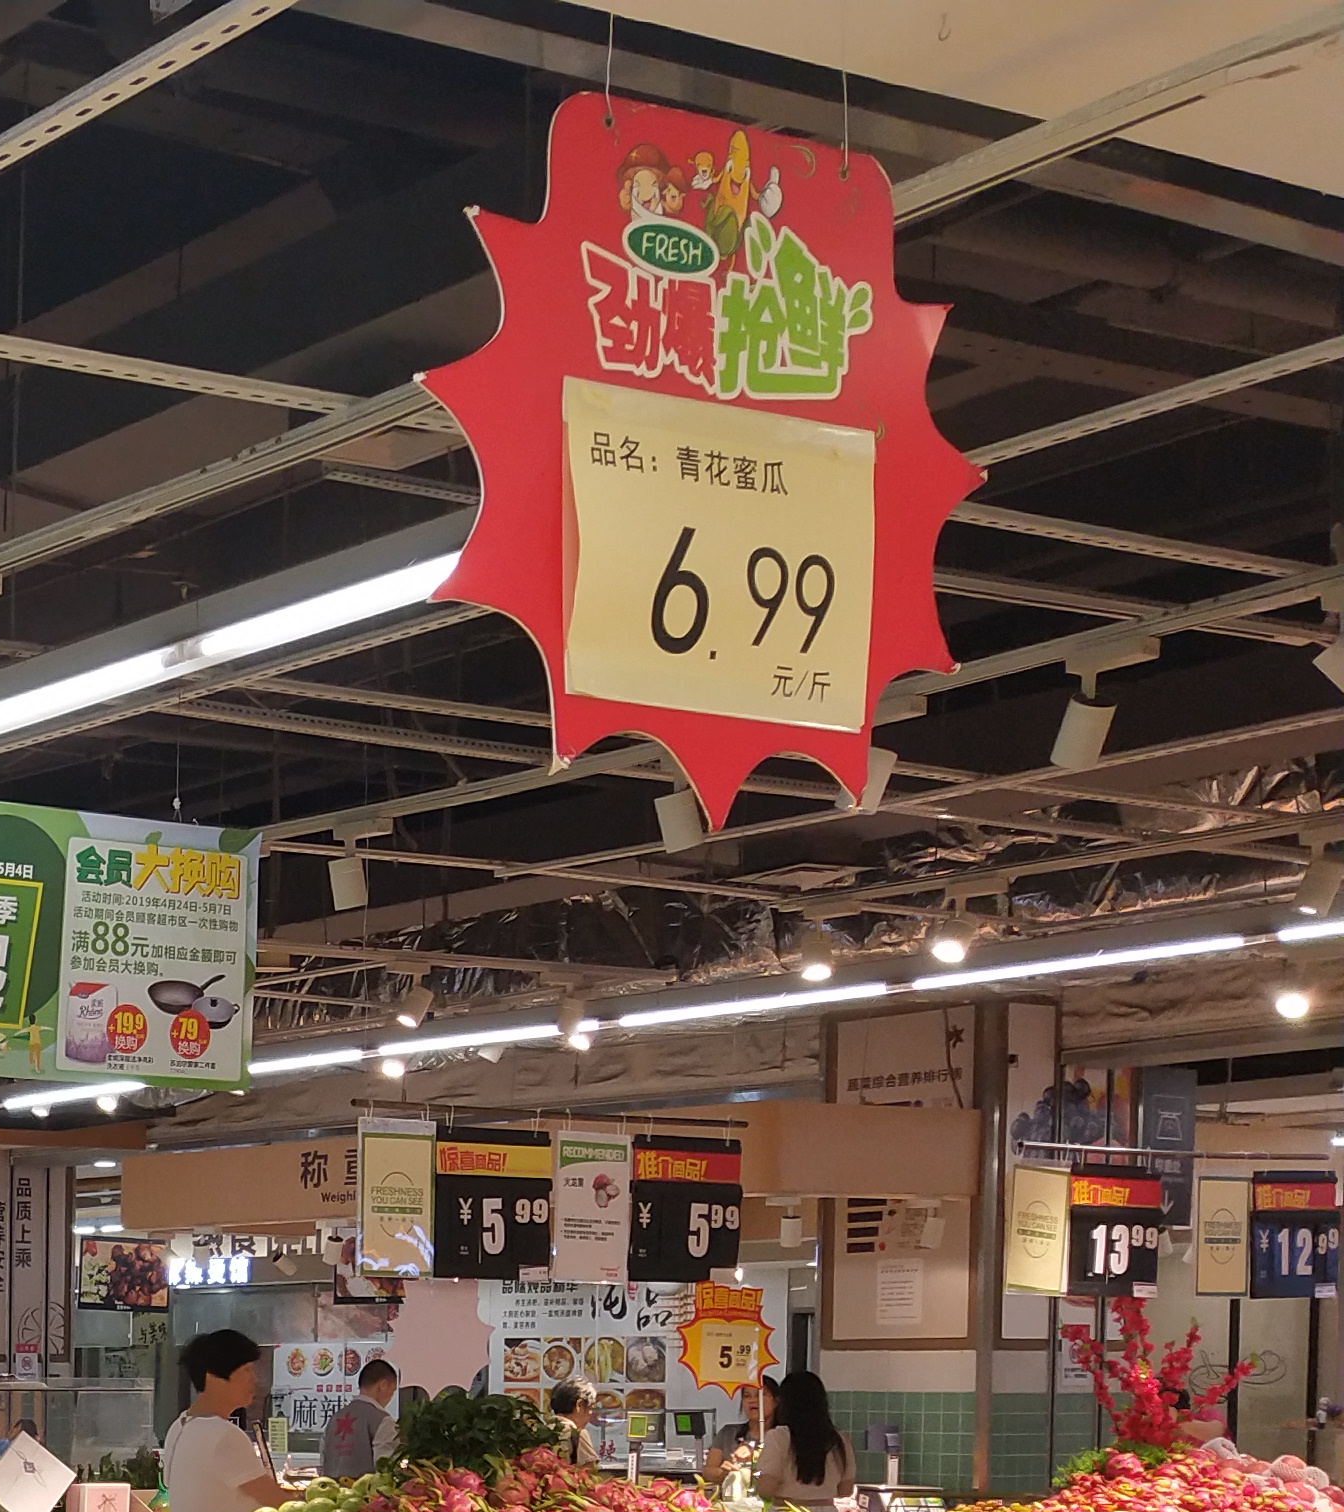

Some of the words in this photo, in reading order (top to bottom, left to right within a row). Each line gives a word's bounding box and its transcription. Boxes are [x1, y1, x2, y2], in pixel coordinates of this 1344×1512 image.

[640, 231, 705, 266] FRESH
[583, 222, 860, 400] 劲爆抢鲜
[651, 526, 837, 661] 6.99
[770, 664, 832, 704] 元/斤
[75, 844, 241, 899] 会员大换购
[562, 1145, 625, 1161] RECOMMENDED
[371, 1186, 423, 1196] FRESHNESS
[372, 1196, 388, 1204] YOU
[390, 1196, 407, 1205] CAN
[408, 1197, 423, 1206] SEE
